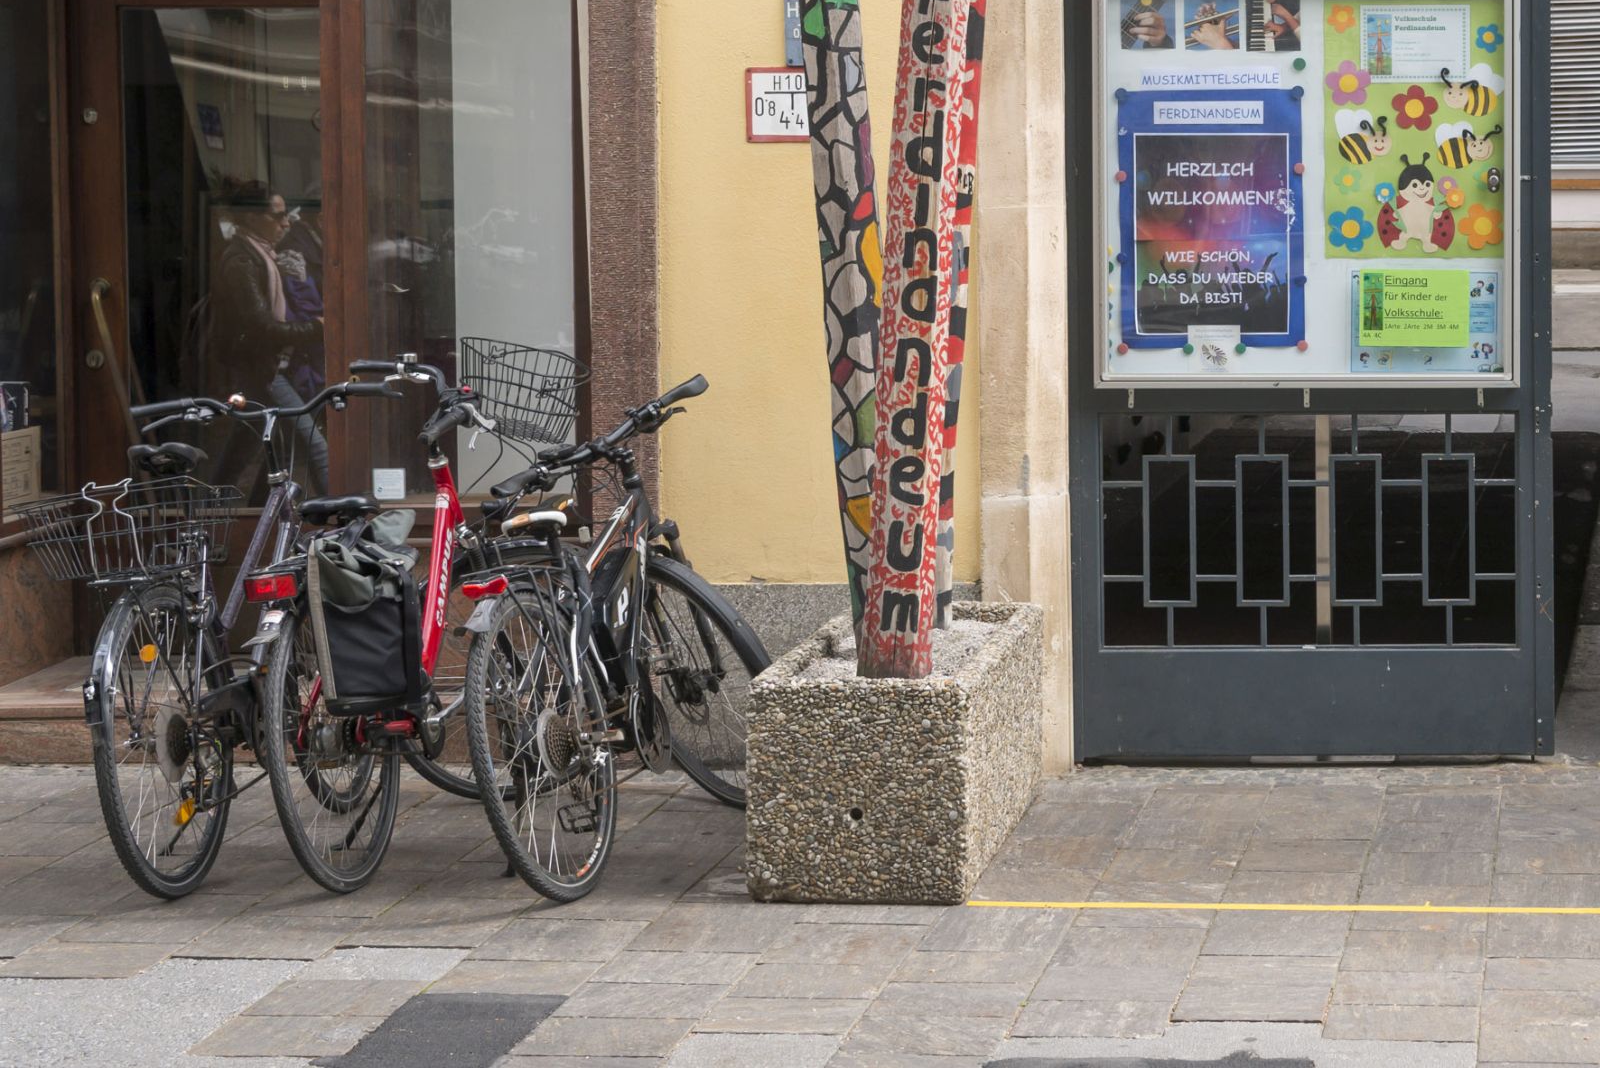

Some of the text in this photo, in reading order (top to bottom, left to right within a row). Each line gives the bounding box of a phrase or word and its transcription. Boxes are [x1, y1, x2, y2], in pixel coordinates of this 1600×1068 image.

[1141, 72, 1280, 86] MUSIKMITTELSCHULE
[1158, 106, 1261, 120] FERDINANDEUM
[1166, 162, 1254, 177] HERZLICH
[1147, 191, 1274, 206] WILLKOMMEN!
[1165, 250, 1195, 263] WIE
[1148, 272, 1274, 284] DASS DU WIEDER
[1384, 275, 1428, 287] Eingang
[1179, 292, 1243, 304] DA BIST!
[1384, 291, 1447, 301] für Kinder der
